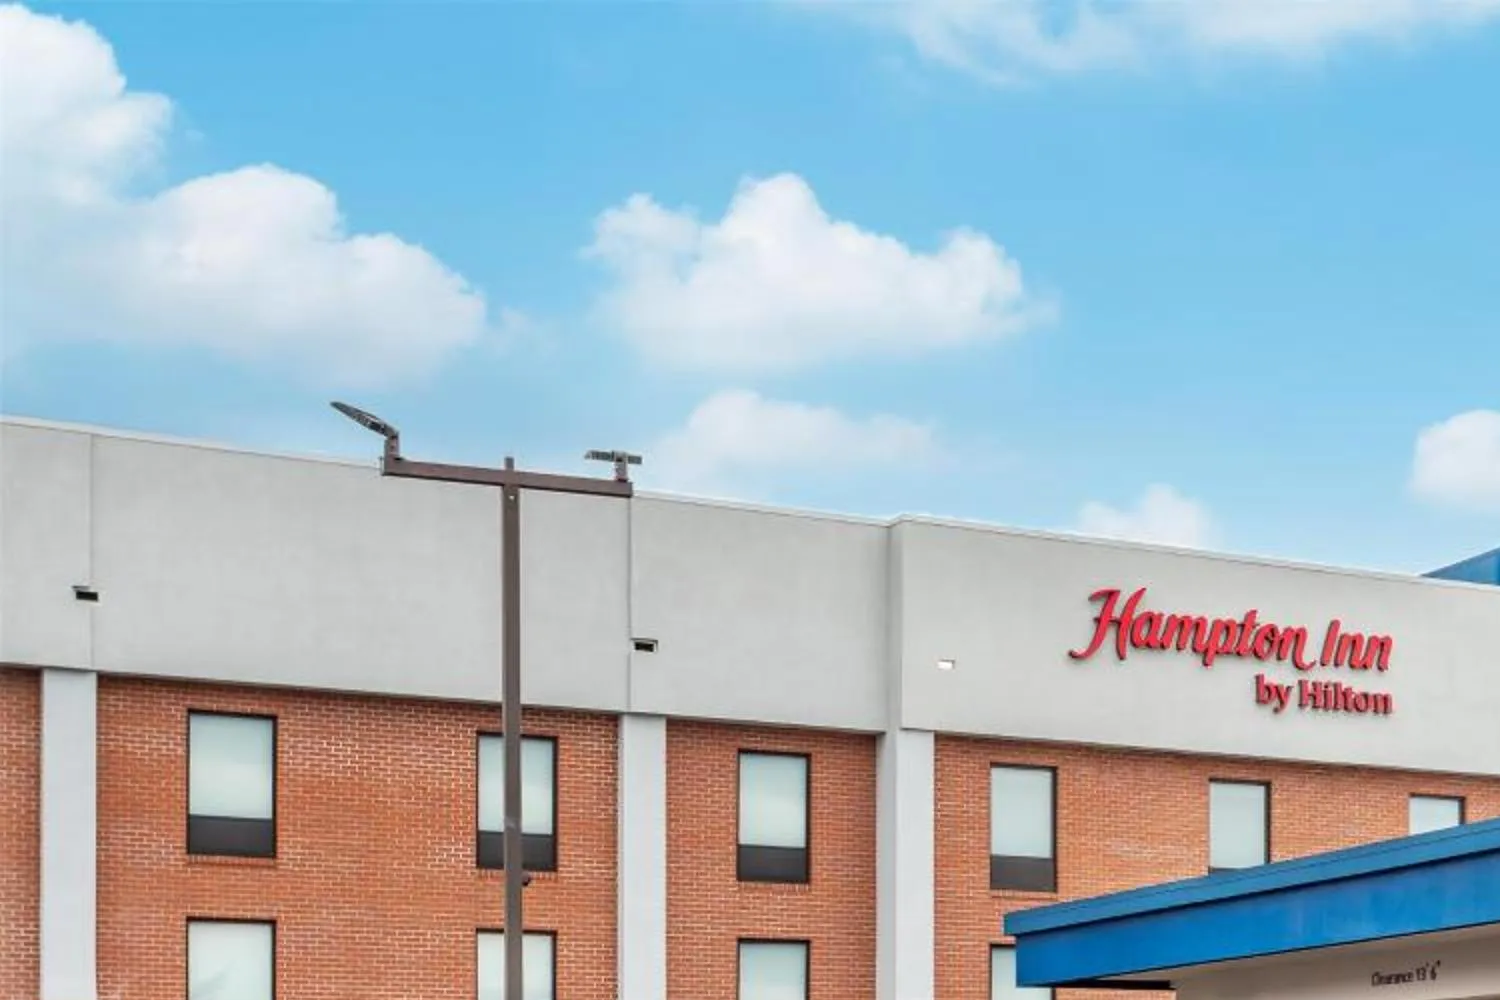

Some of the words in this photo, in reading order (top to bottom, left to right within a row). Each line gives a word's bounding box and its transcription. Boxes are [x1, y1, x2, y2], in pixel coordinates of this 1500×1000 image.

[1068, 587, 1315, 671] Hampton
[1320, 619, 1393, 671] Inn
[1254, 674, 1291, 713] by
[1298, 679, 1393, 714] Hilton
